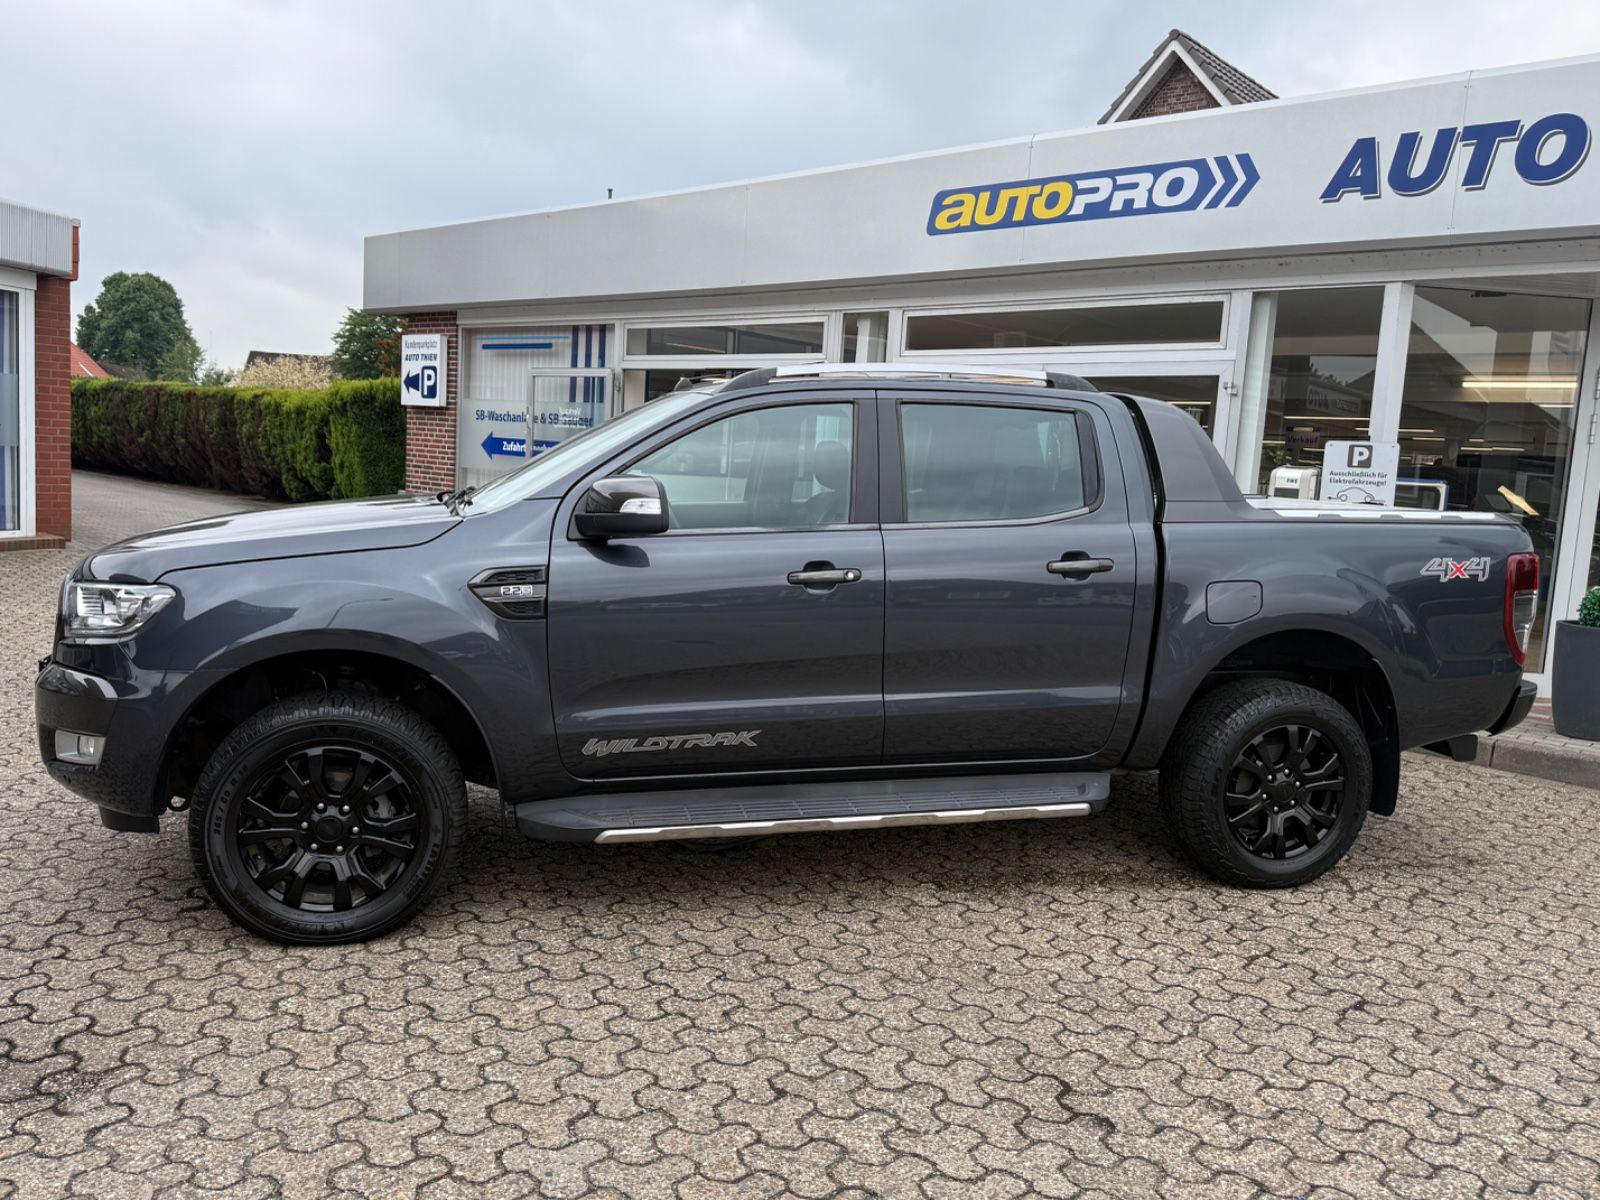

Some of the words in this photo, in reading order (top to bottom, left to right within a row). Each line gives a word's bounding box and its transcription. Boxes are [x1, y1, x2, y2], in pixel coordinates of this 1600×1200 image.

[1319, 112, 1592, 204] AUTO
[405, 353, 419, 362] AUTO
[420, 352, 438, 362] THIEN
[423, 368, 436, 396] P
[540, 413, 546, 424] &
[1352, 447, 1370, 466] P
[1377, 471, 1388, 479] für
[581, 729, 762, 757] WILDTRAK
